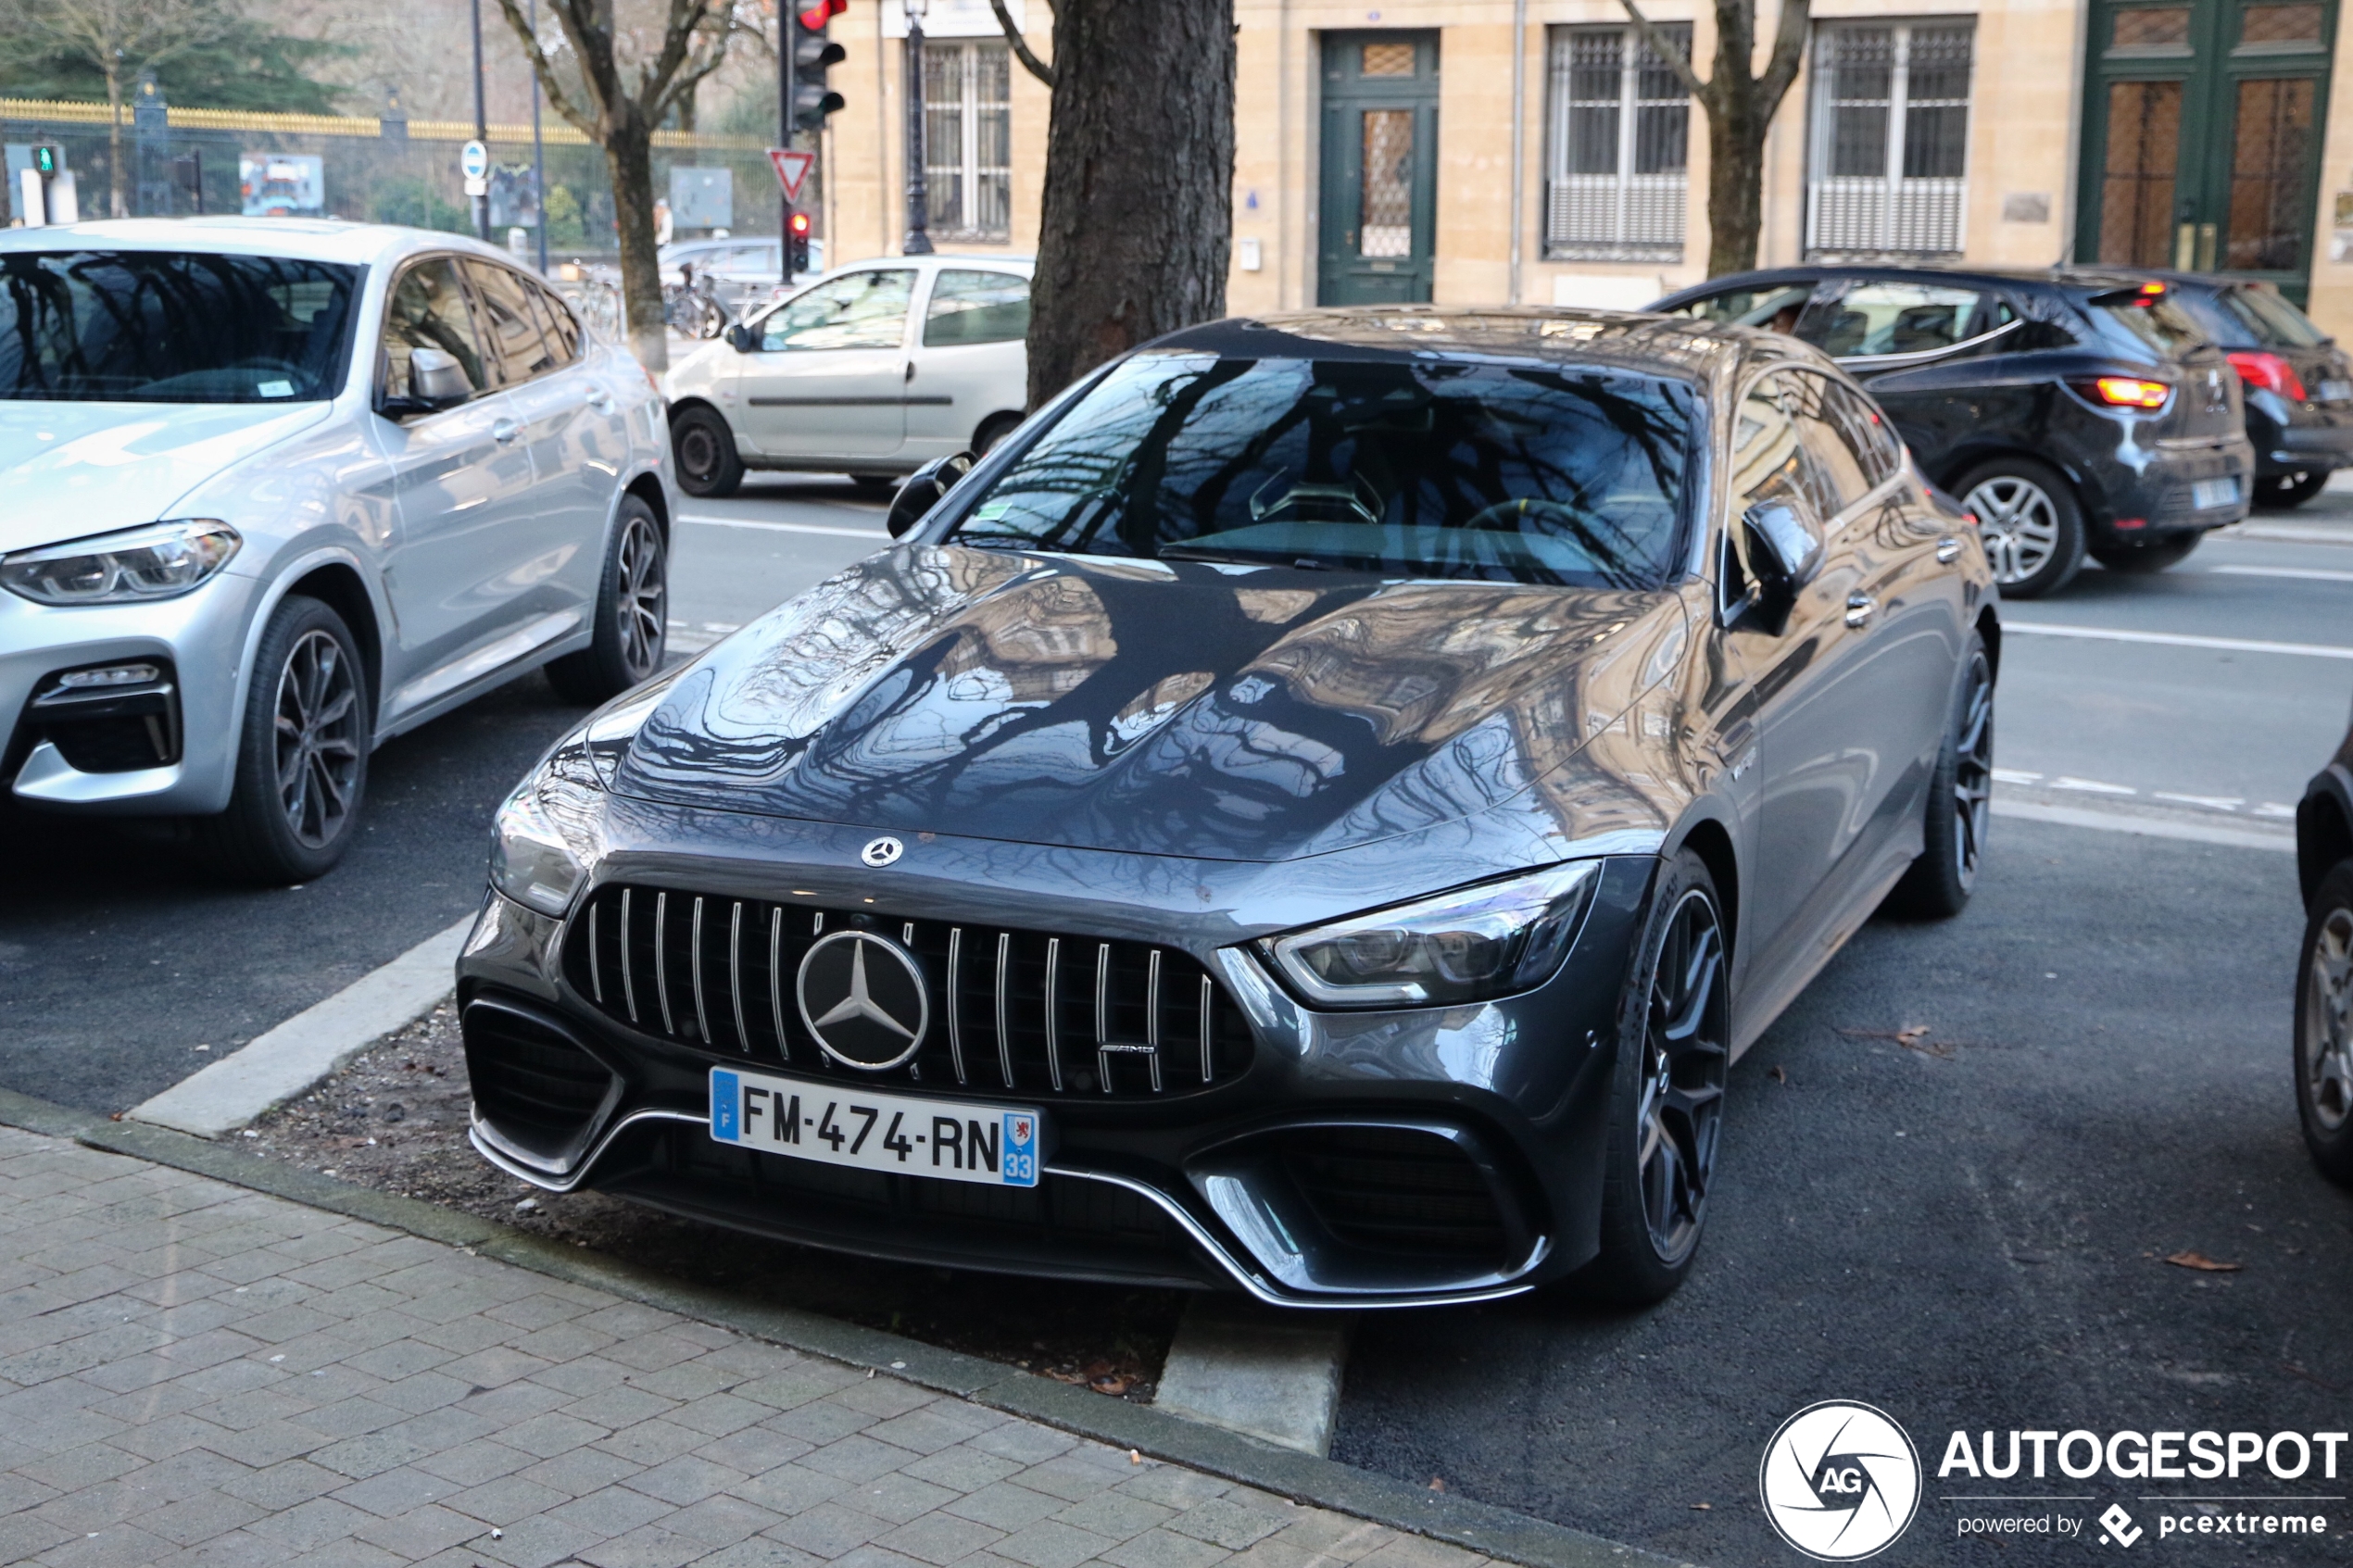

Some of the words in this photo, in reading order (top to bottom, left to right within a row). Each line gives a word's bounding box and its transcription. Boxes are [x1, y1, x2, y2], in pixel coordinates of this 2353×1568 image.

[721, 1112, 731, 1128] F
[744, 1085, 1000, 1173] FM-474-RN
[1005, 1153, 1033, 1180] 33
